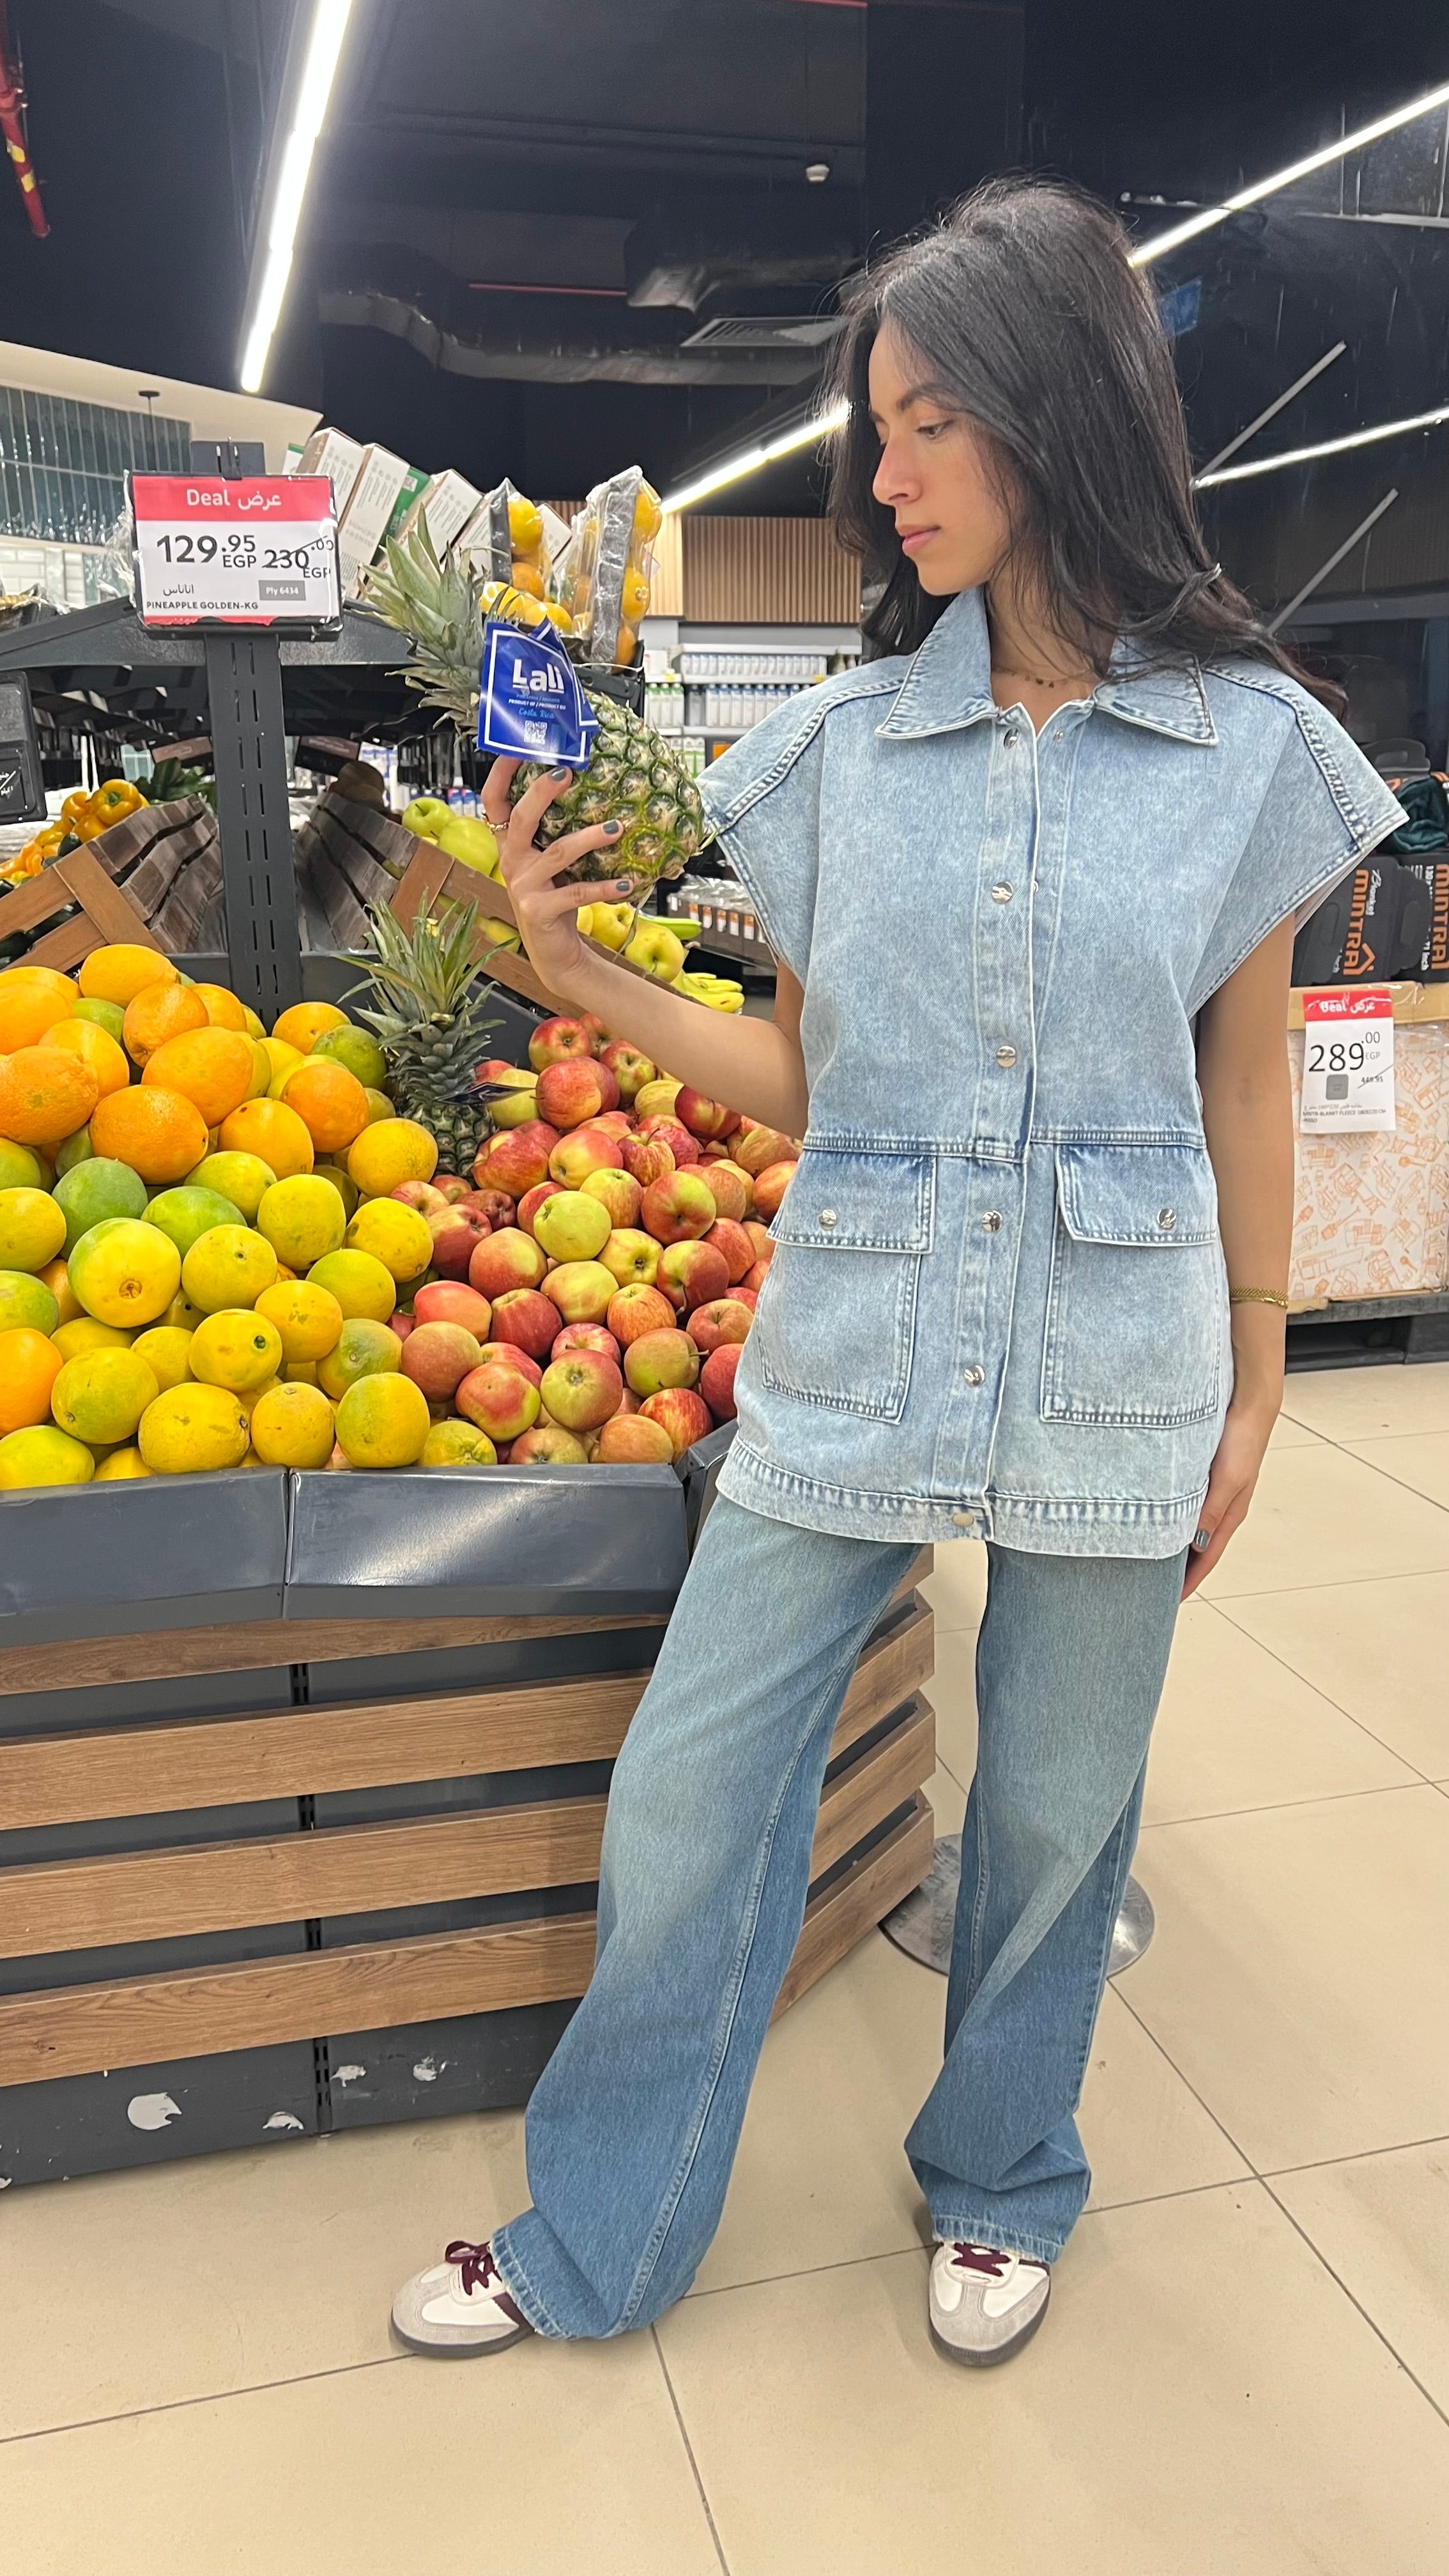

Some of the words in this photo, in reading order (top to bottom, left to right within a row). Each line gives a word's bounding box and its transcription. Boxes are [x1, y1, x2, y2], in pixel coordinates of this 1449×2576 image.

[187, 489, 230, 506] Deal
[238, 490, 282, 511] عرض
[223, 555, 257, 568] EGP
[266, 586, 279, 595] Ply
[279, 586, 299, 595] 6434
[146, 601, 198, 610] PINEAPPLE
[199, 601, 258, 610] GOLDEN-KG
[512, 659, 565, 694] Lali
[519, 707, 538, 717] Costa
[540, 709, 555, 719] Rica
[1319, 1001, 1347, 1013] Deal
[1365, 1052, 1381, 1061] EGP
